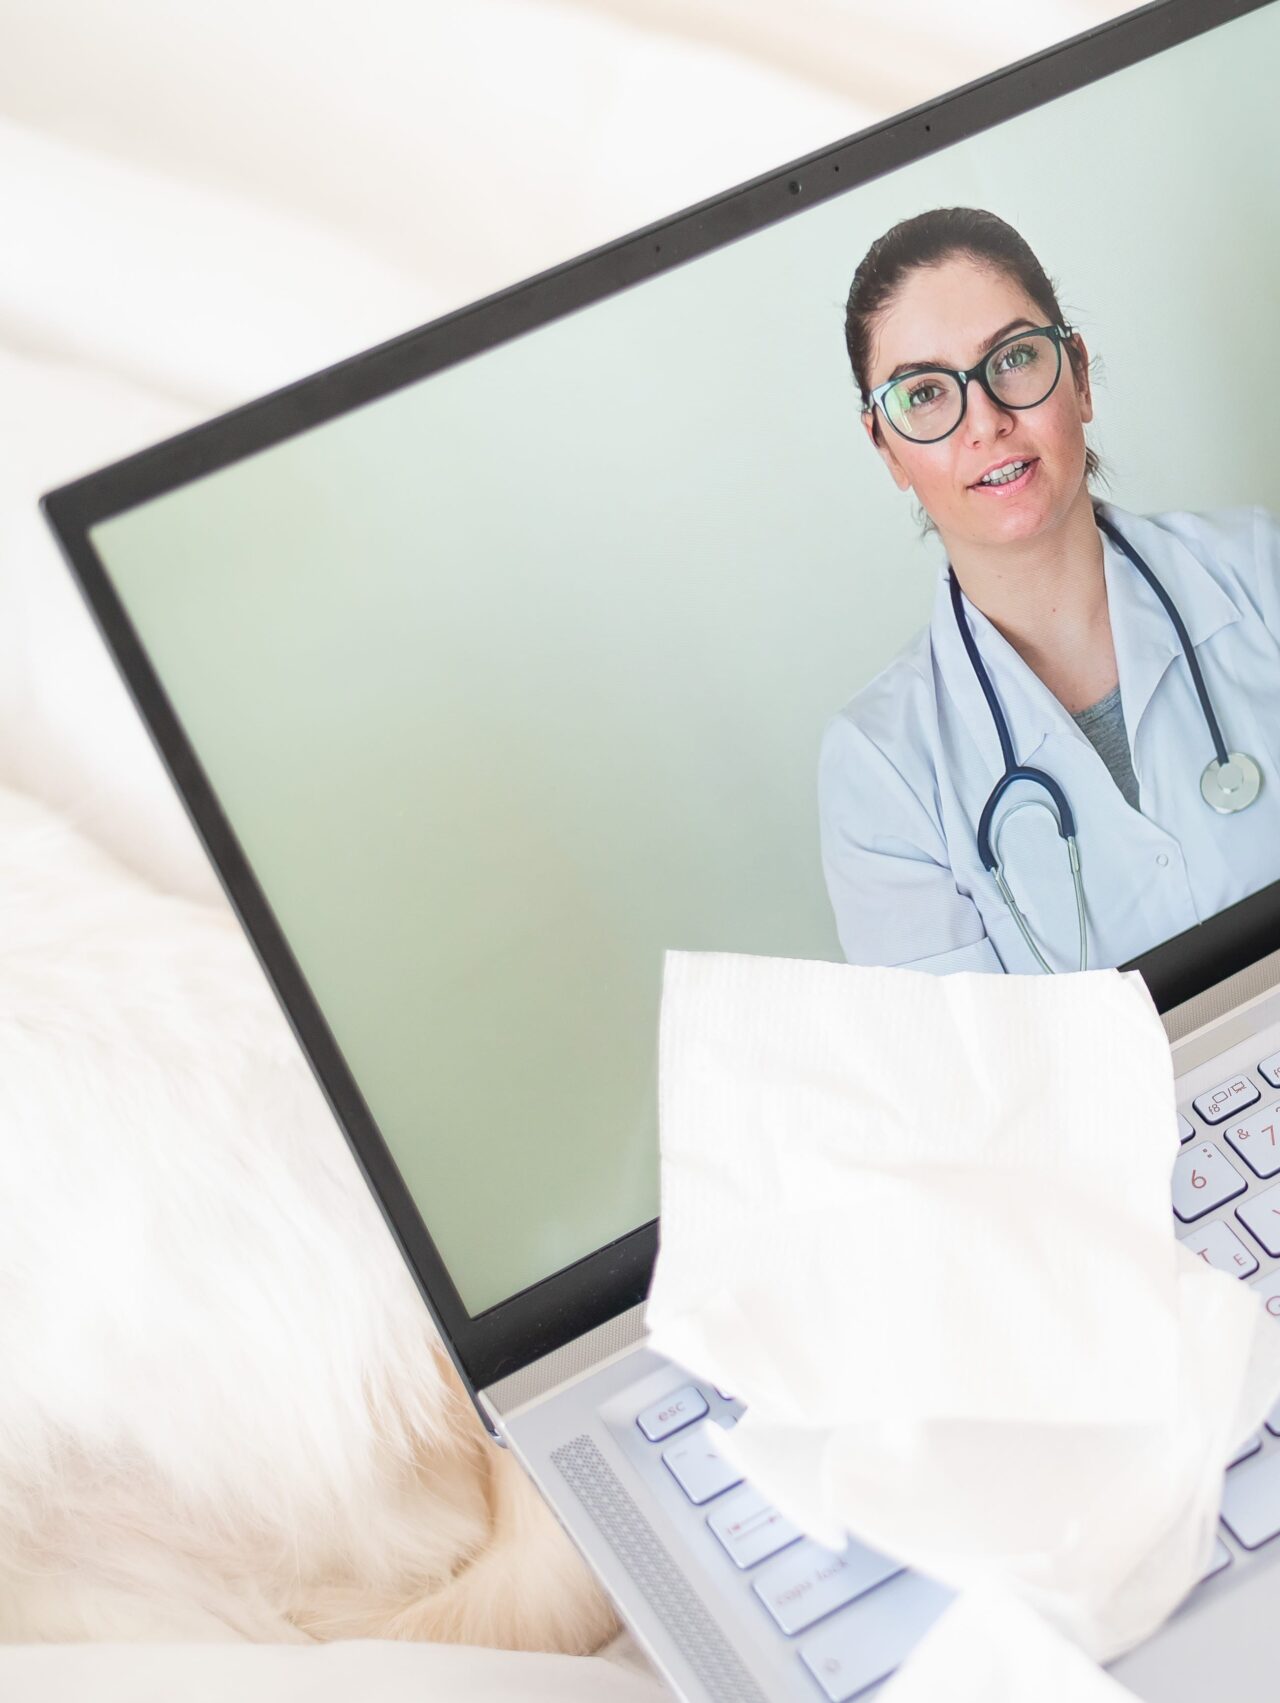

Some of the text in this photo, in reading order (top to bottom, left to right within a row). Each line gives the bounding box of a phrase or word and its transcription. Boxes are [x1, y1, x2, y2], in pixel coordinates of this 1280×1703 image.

[1208, 1104, 1220, 1115] f8
[1261, 1125, 1275, 1146] 7
[1192, 1170, 1207, 1189] 6
[658, 1400, 687, 1423] esc
